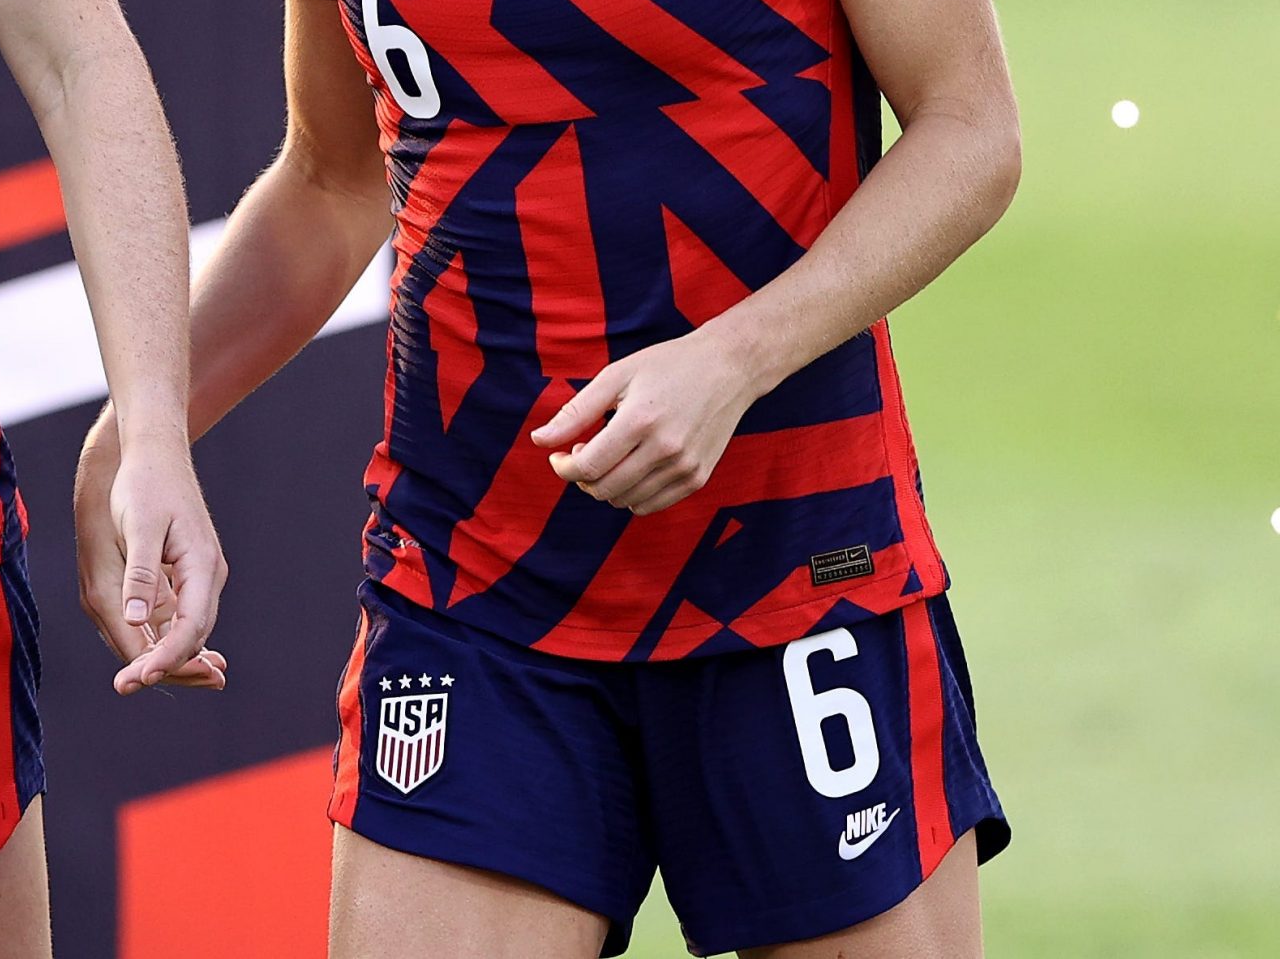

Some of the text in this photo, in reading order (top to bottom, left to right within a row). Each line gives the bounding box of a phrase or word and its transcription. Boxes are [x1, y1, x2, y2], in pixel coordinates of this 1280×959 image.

[383, 697, 444, 738] USA
[783, 627, 881, 798] 6
[845, 802, 887, 840] NIKE
